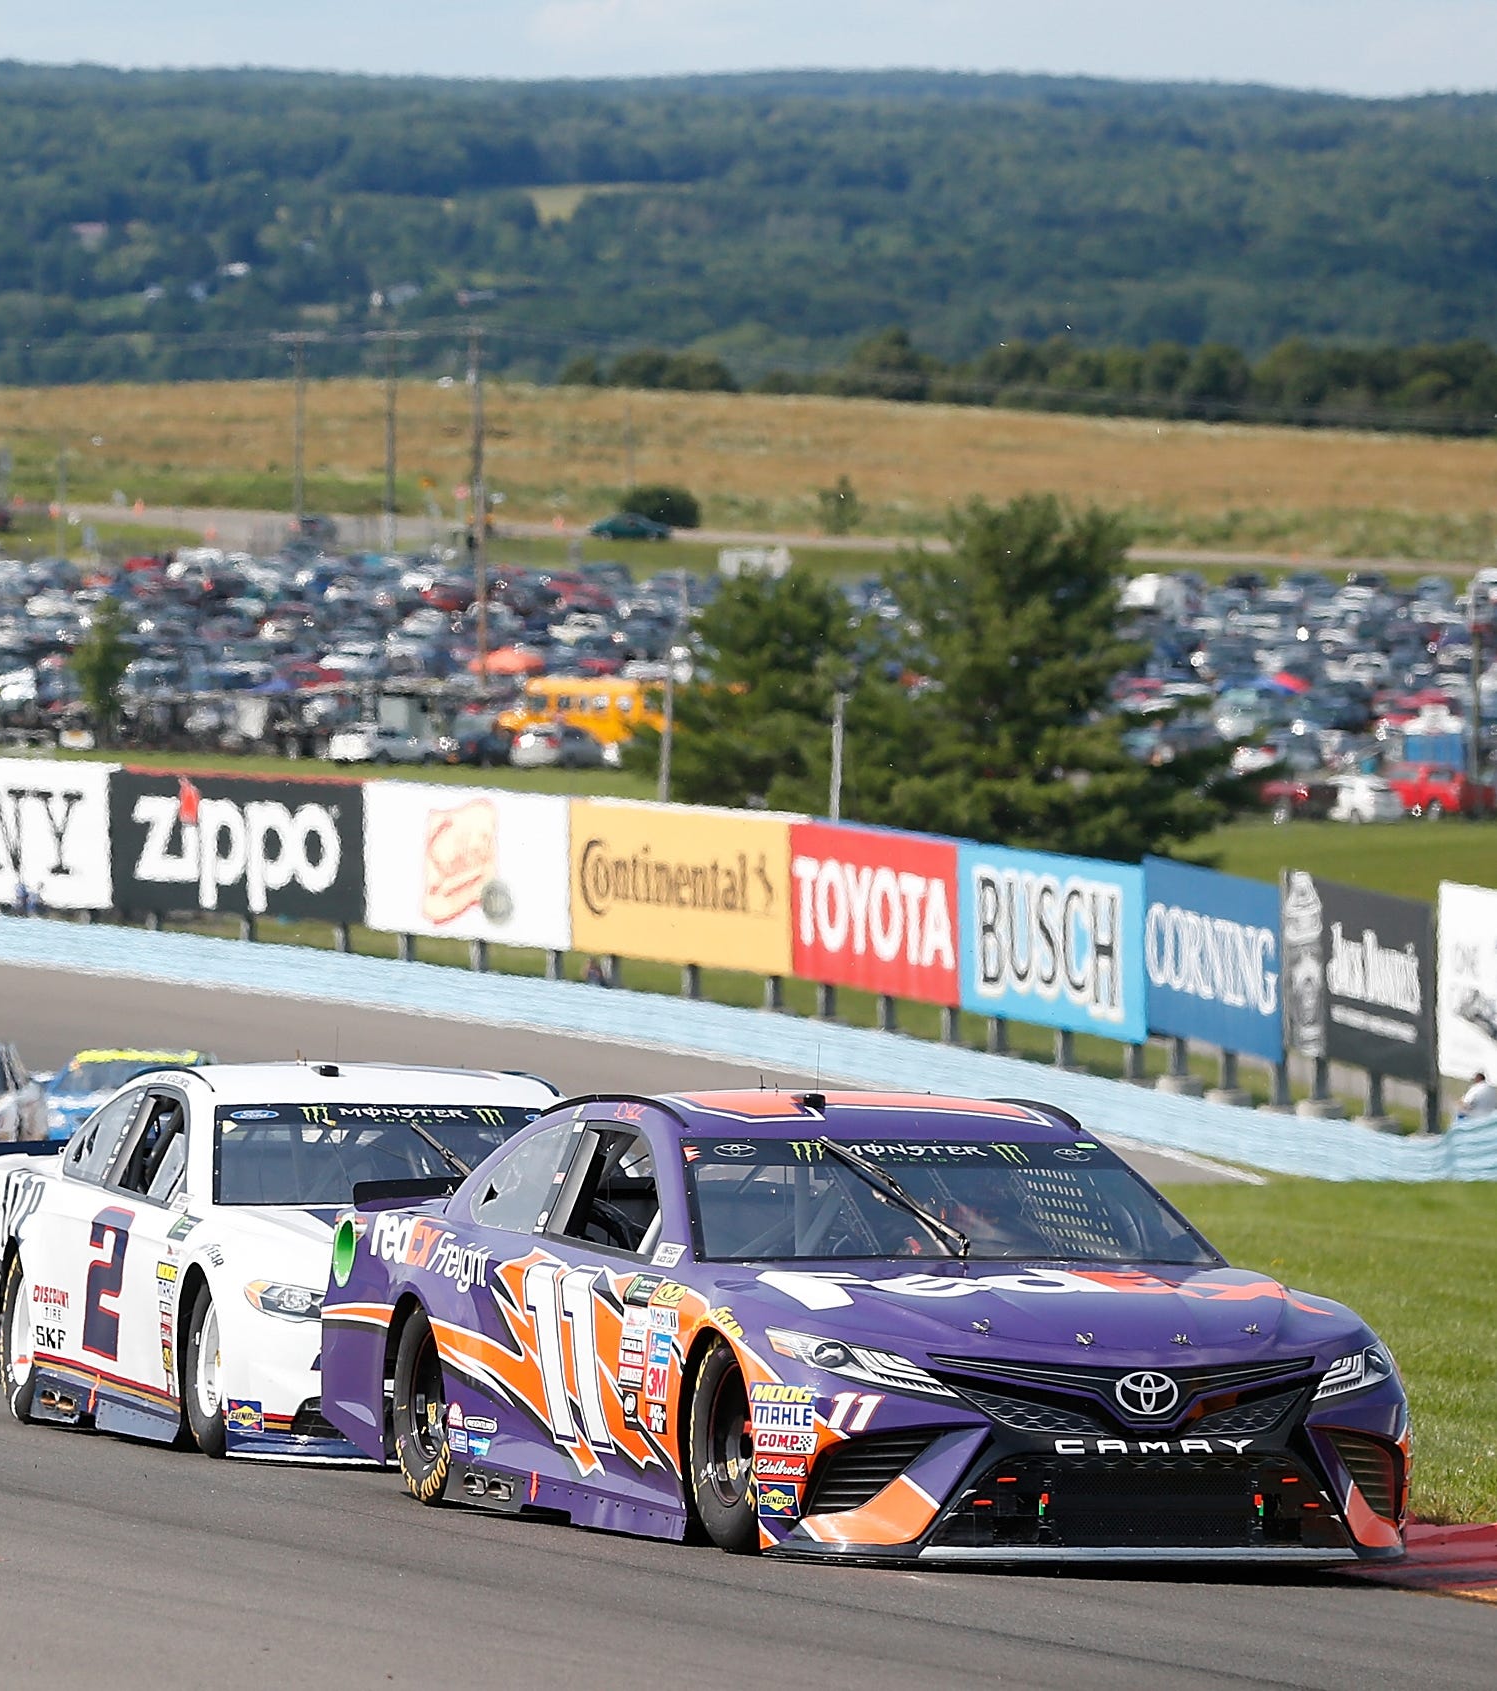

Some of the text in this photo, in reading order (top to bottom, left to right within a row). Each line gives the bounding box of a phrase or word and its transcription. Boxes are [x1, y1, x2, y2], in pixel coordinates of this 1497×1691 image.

[581, 838, 749, 916] Continental
[793, 855, 956, 969] TOYOTA
[975, 868, 1122, 1018] BUSCH
[1146, 902, 1278, 1015] CORNING
[339, 1107, 469, 1120] MONSTER
[844, 1143, 987, 1158] MONSTER
[426, 1232, 493, 1293] Freight
[33, 1285, 70, 1310] DISCOUNT
[82, 1205, 136, 1362] 2
[756, 1268, 1334, 1316] FedEx
[44, 1306, 63, 1321] TIRE
[36, 1326, 67, 1350] SKF
[523, 1258, 617, 1455] 11
[647, 1367, 667, 1398] 3M
[750, 1384, 816, 1403] MOOG
[754, 1405, 813, 1427] MAHLE
[826, 1391, 886, 1433] 11
[758, 1433, 800, 1449] COMP
[756, 1459, 807, 1477] Edelbrock
[760, 1494, 794, 1505] SUNOCO
